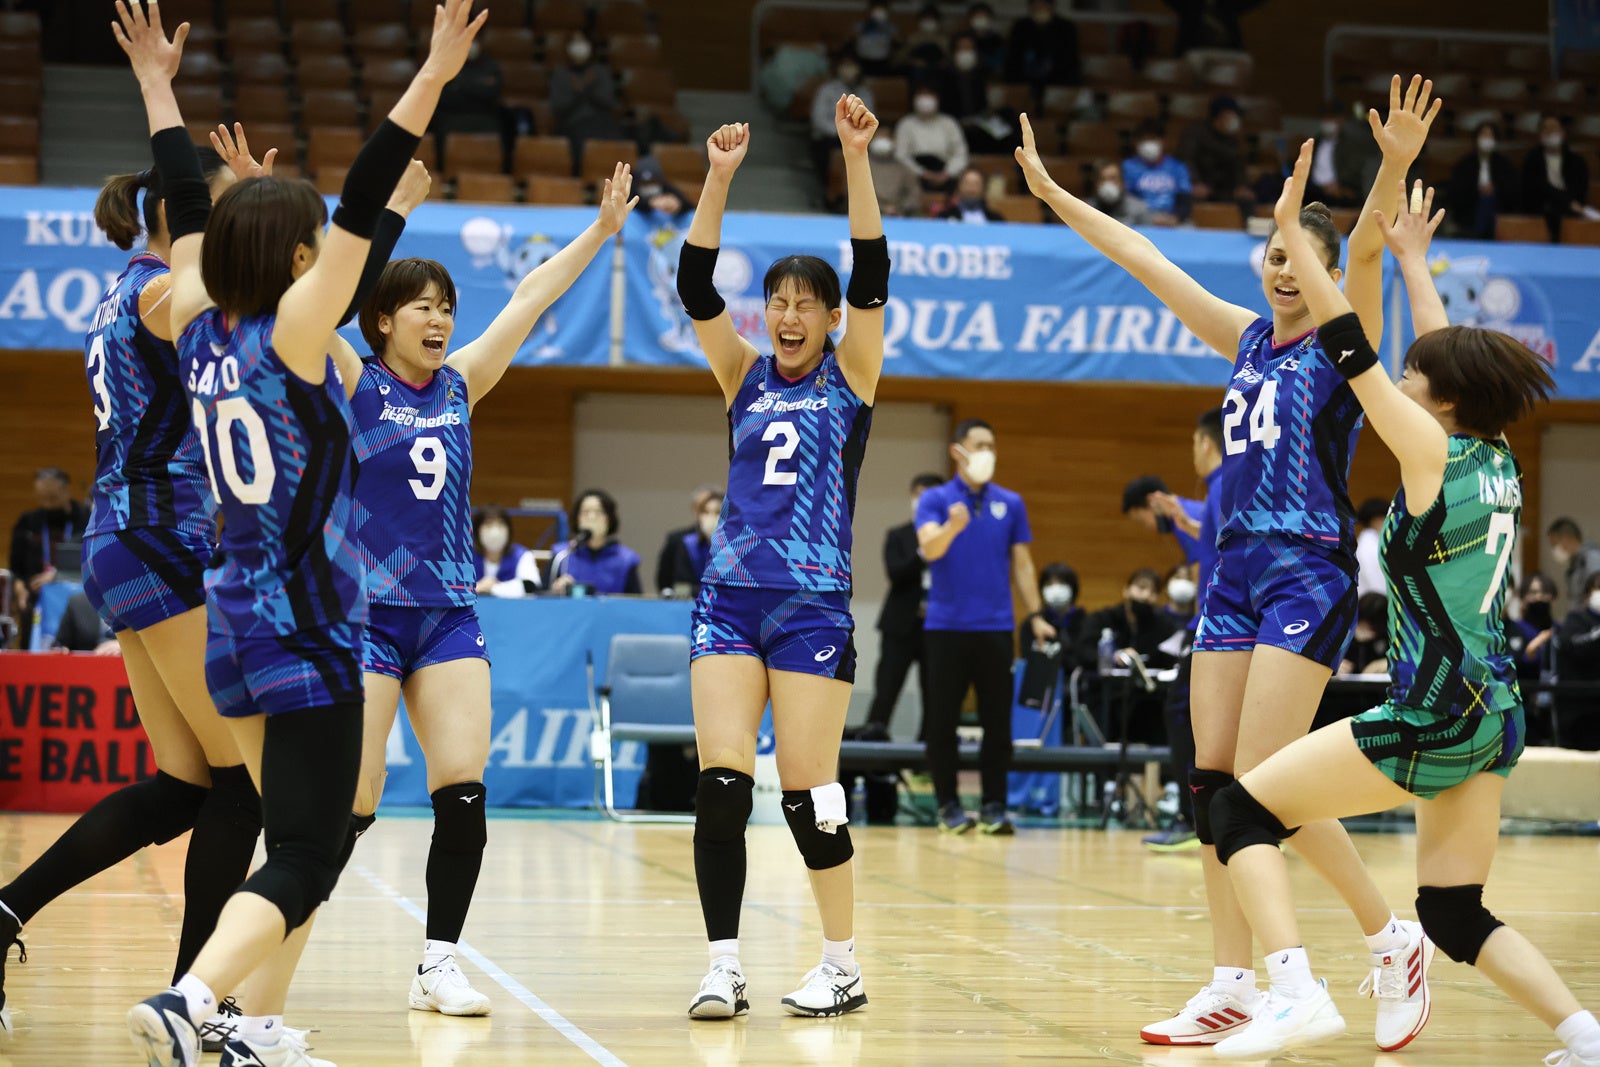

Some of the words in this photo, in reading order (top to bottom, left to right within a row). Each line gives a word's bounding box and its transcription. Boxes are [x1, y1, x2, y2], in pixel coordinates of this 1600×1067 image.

[837, 240, 1012, 280] ROBE
[840, 297, 1003, 358] QUA
[87, 333, 112, 432] 3
[1222, 379, 1281, 456] 24
[192, 396, 277, 505] 10
[407, 436, 447, 501] 9
[761, 421, 801, 486] 2
[1479, 511, 1515, 614] 7
[696, 623, 708, 645] 2
[0, 684, 97, 730] VER
[1421, 655, 1452, 709] AITAMA
[40, 738, 158, 784] BALL
